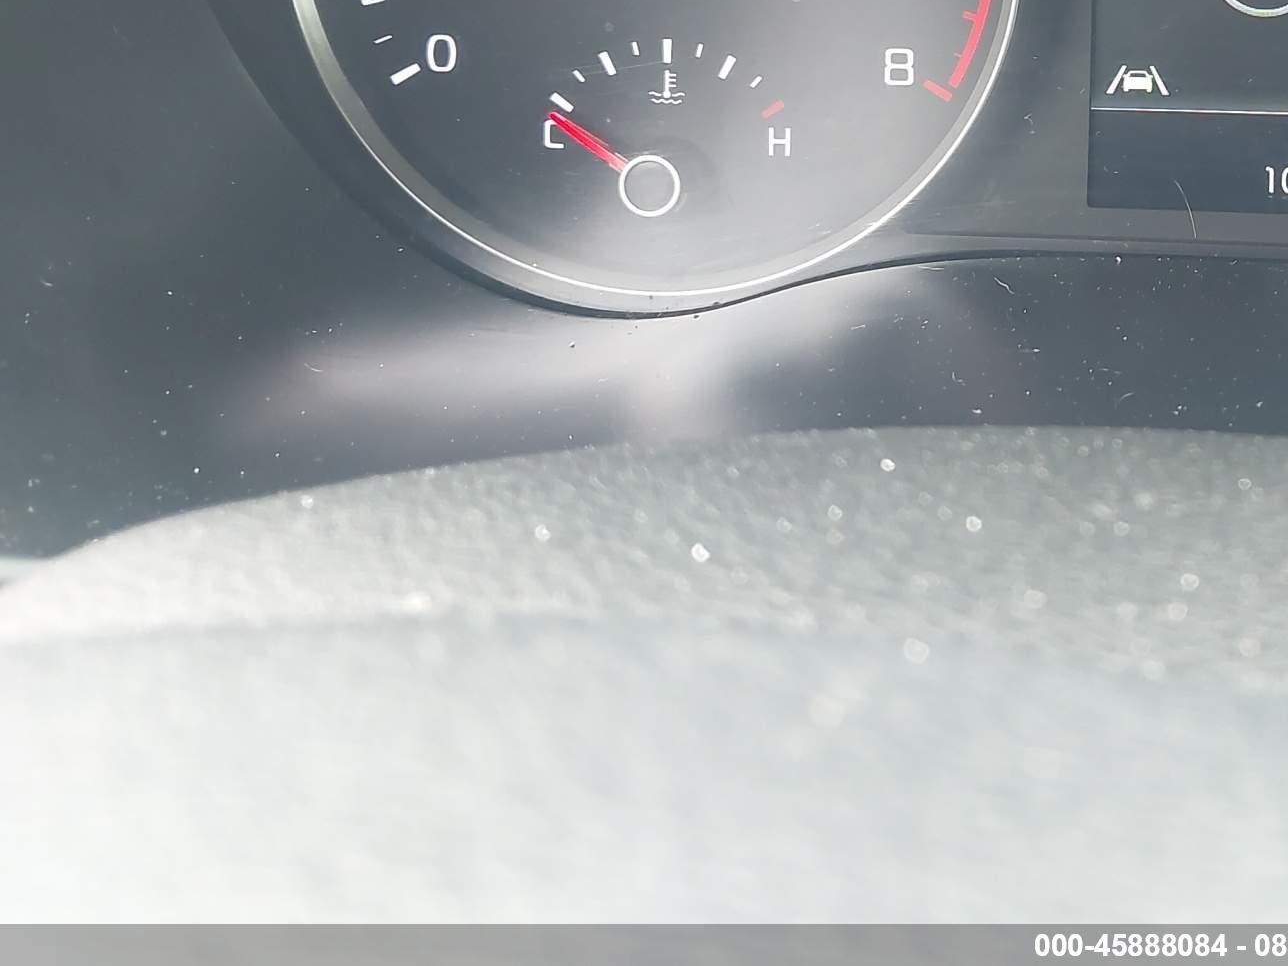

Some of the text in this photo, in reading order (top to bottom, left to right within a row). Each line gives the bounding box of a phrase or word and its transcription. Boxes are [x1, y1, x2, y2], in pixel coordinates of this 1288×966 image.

[427, 35, 456, 71] 0
[885, 49, 913, 85] 8
[544, 119, 566, 149] C
[769, 128, 790, 156] H
